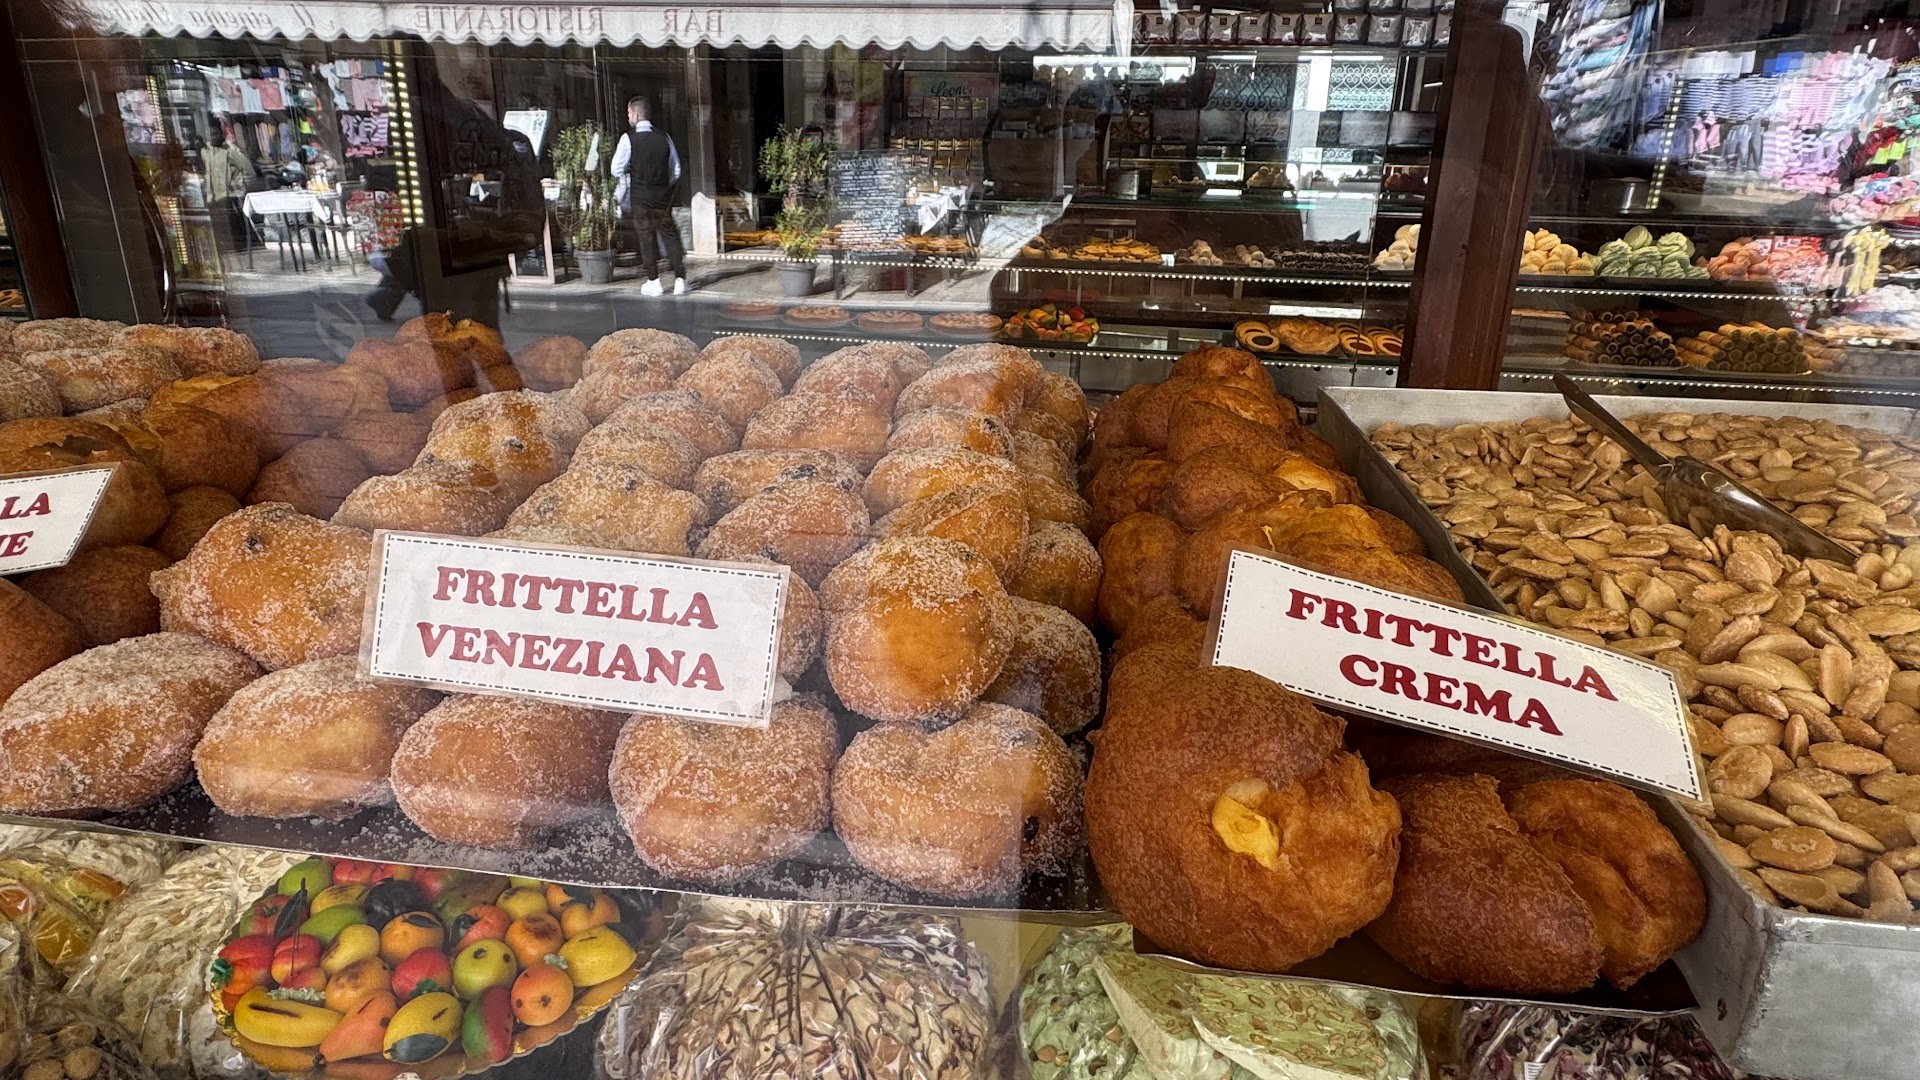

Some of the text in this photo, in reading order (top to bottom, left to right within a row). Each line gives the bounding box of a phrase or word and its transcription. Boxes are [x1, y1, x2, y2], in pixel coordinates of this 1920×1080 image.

[0, 492, 51, 520] LA
[432, 566, 720, 630] FRITTELLA
[417, 622, 725, 692] VENEZIANA
[1286, 587, 1618, 702] FRITTELLA
[1340, 653, 1564, 736] CREMA
